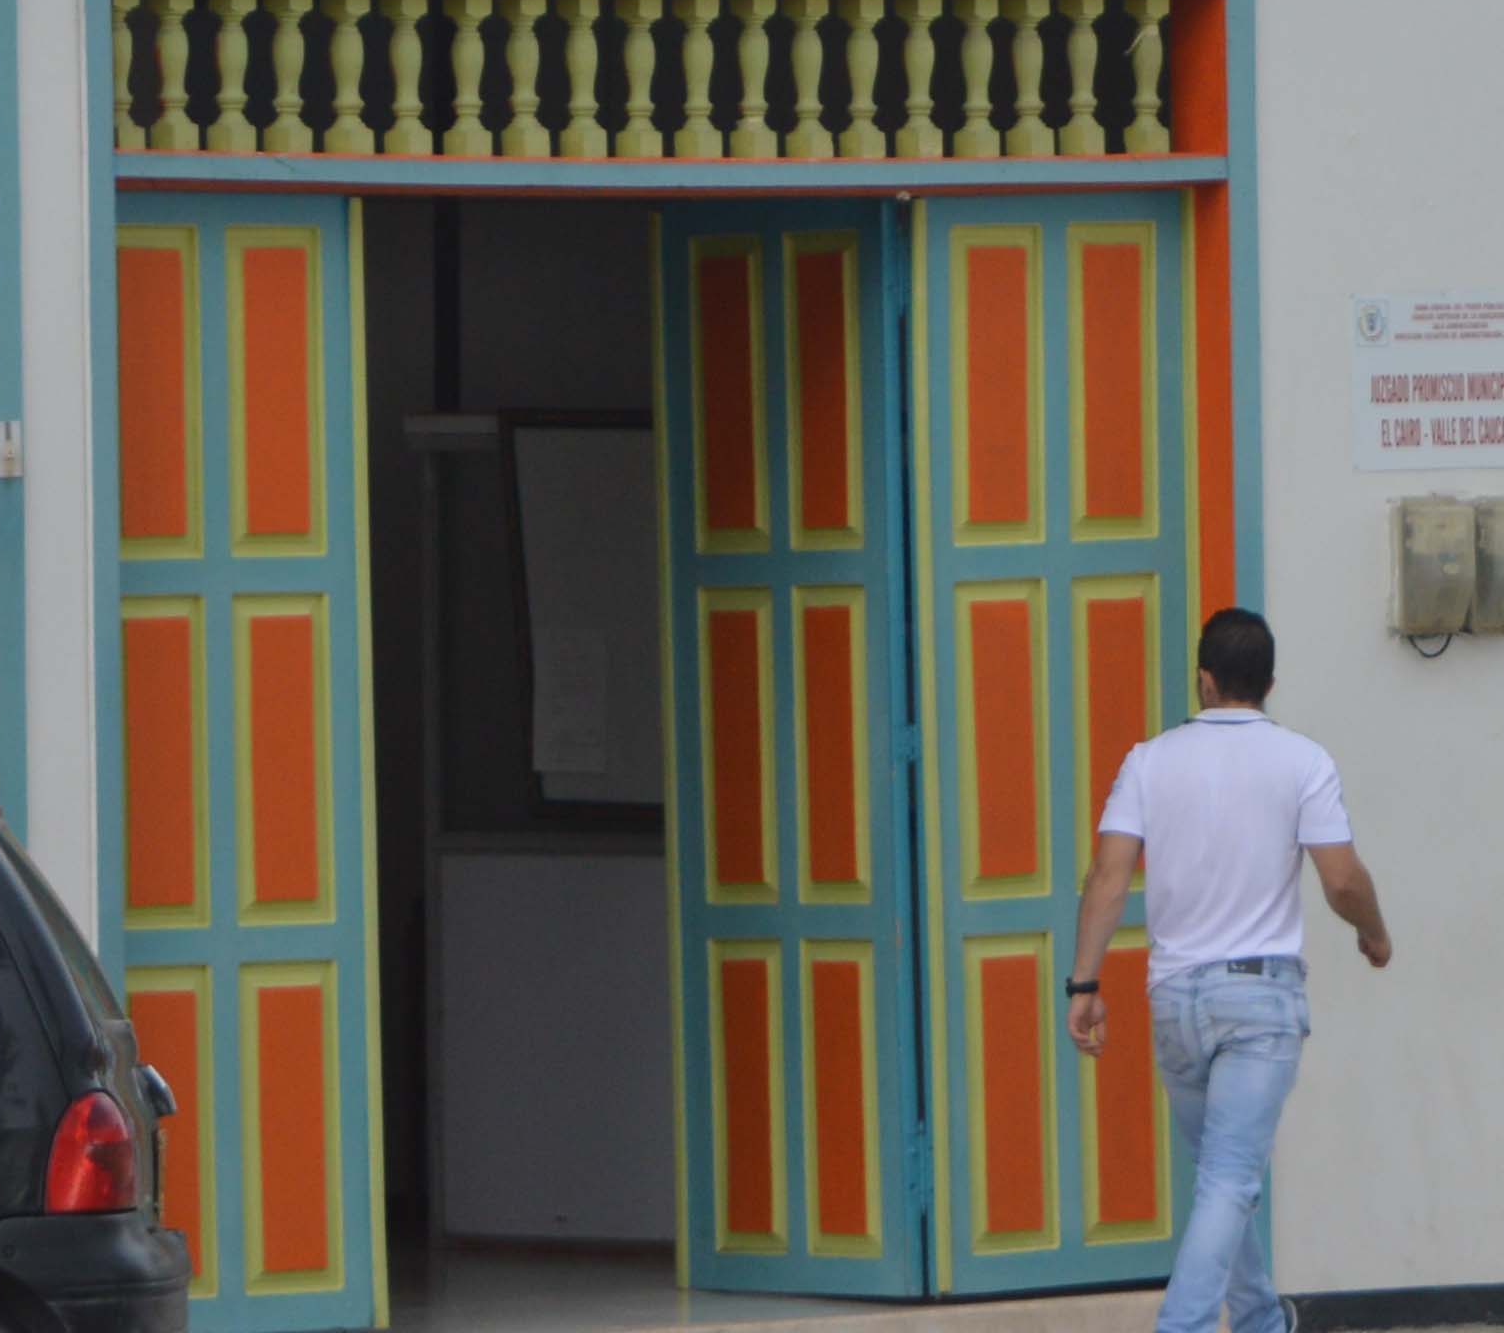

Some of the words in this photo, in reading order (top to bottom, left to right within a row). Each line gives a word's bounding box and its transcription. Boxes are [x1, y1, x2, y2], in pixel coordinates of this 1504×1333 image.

[1370, 374, 1409, 403] JUZGADO
[1381, 418, 1392, 448] EL
[1394, 417, 1421, 447] CAIRO
[1431, 416, 1457, 446] VALLE
[1459, 416, 1476, 445] DEL
